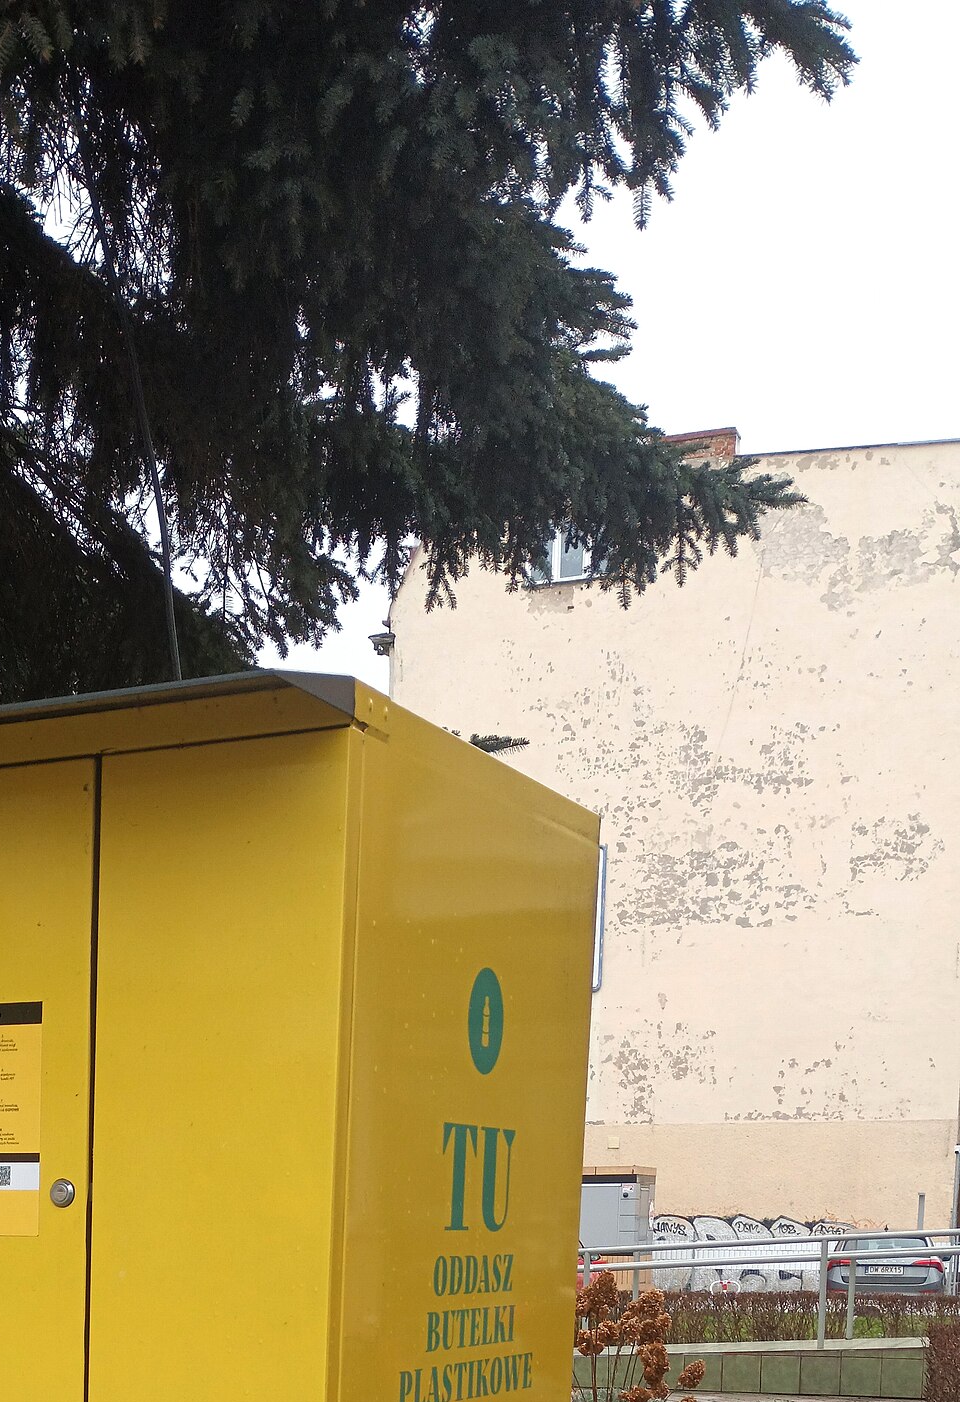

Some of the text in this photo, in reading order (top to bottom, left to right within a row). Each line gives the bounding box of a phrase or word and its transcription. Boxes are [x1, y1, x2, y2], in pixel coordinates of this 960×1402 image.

[442, 1122, 516, 1232] TU
[433, 1254, 514, 1297] ODDASZ
[425, 1305, 516, 1353] BUTELKI
